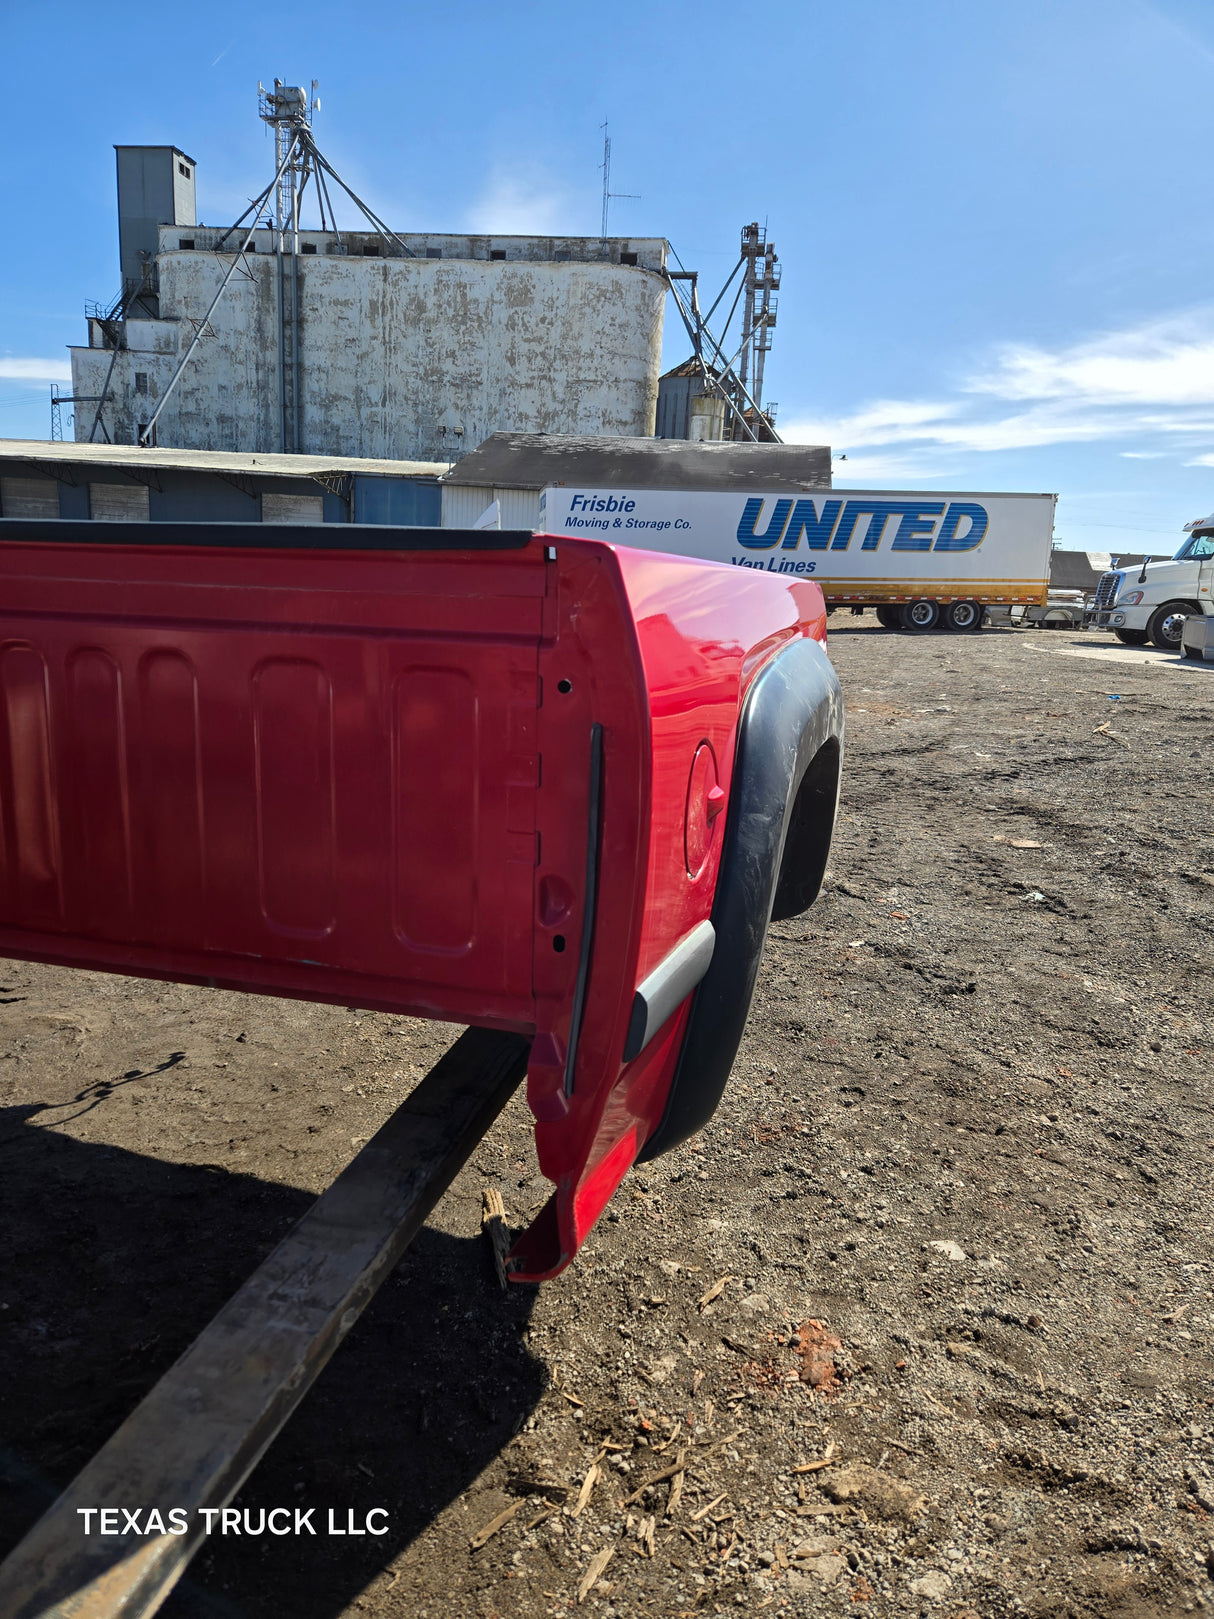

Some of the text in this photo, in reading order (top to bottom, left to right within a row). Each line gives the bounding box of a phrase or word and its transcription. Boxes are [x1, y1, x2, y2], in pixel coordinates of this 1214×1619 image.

[570, 495, 636, 513] Frisbie
[565, 517, 693, 531] Moving & Storage Co.
[736, 497, 989, 552] UNITED
[767, 557, 817, 573] Lines
